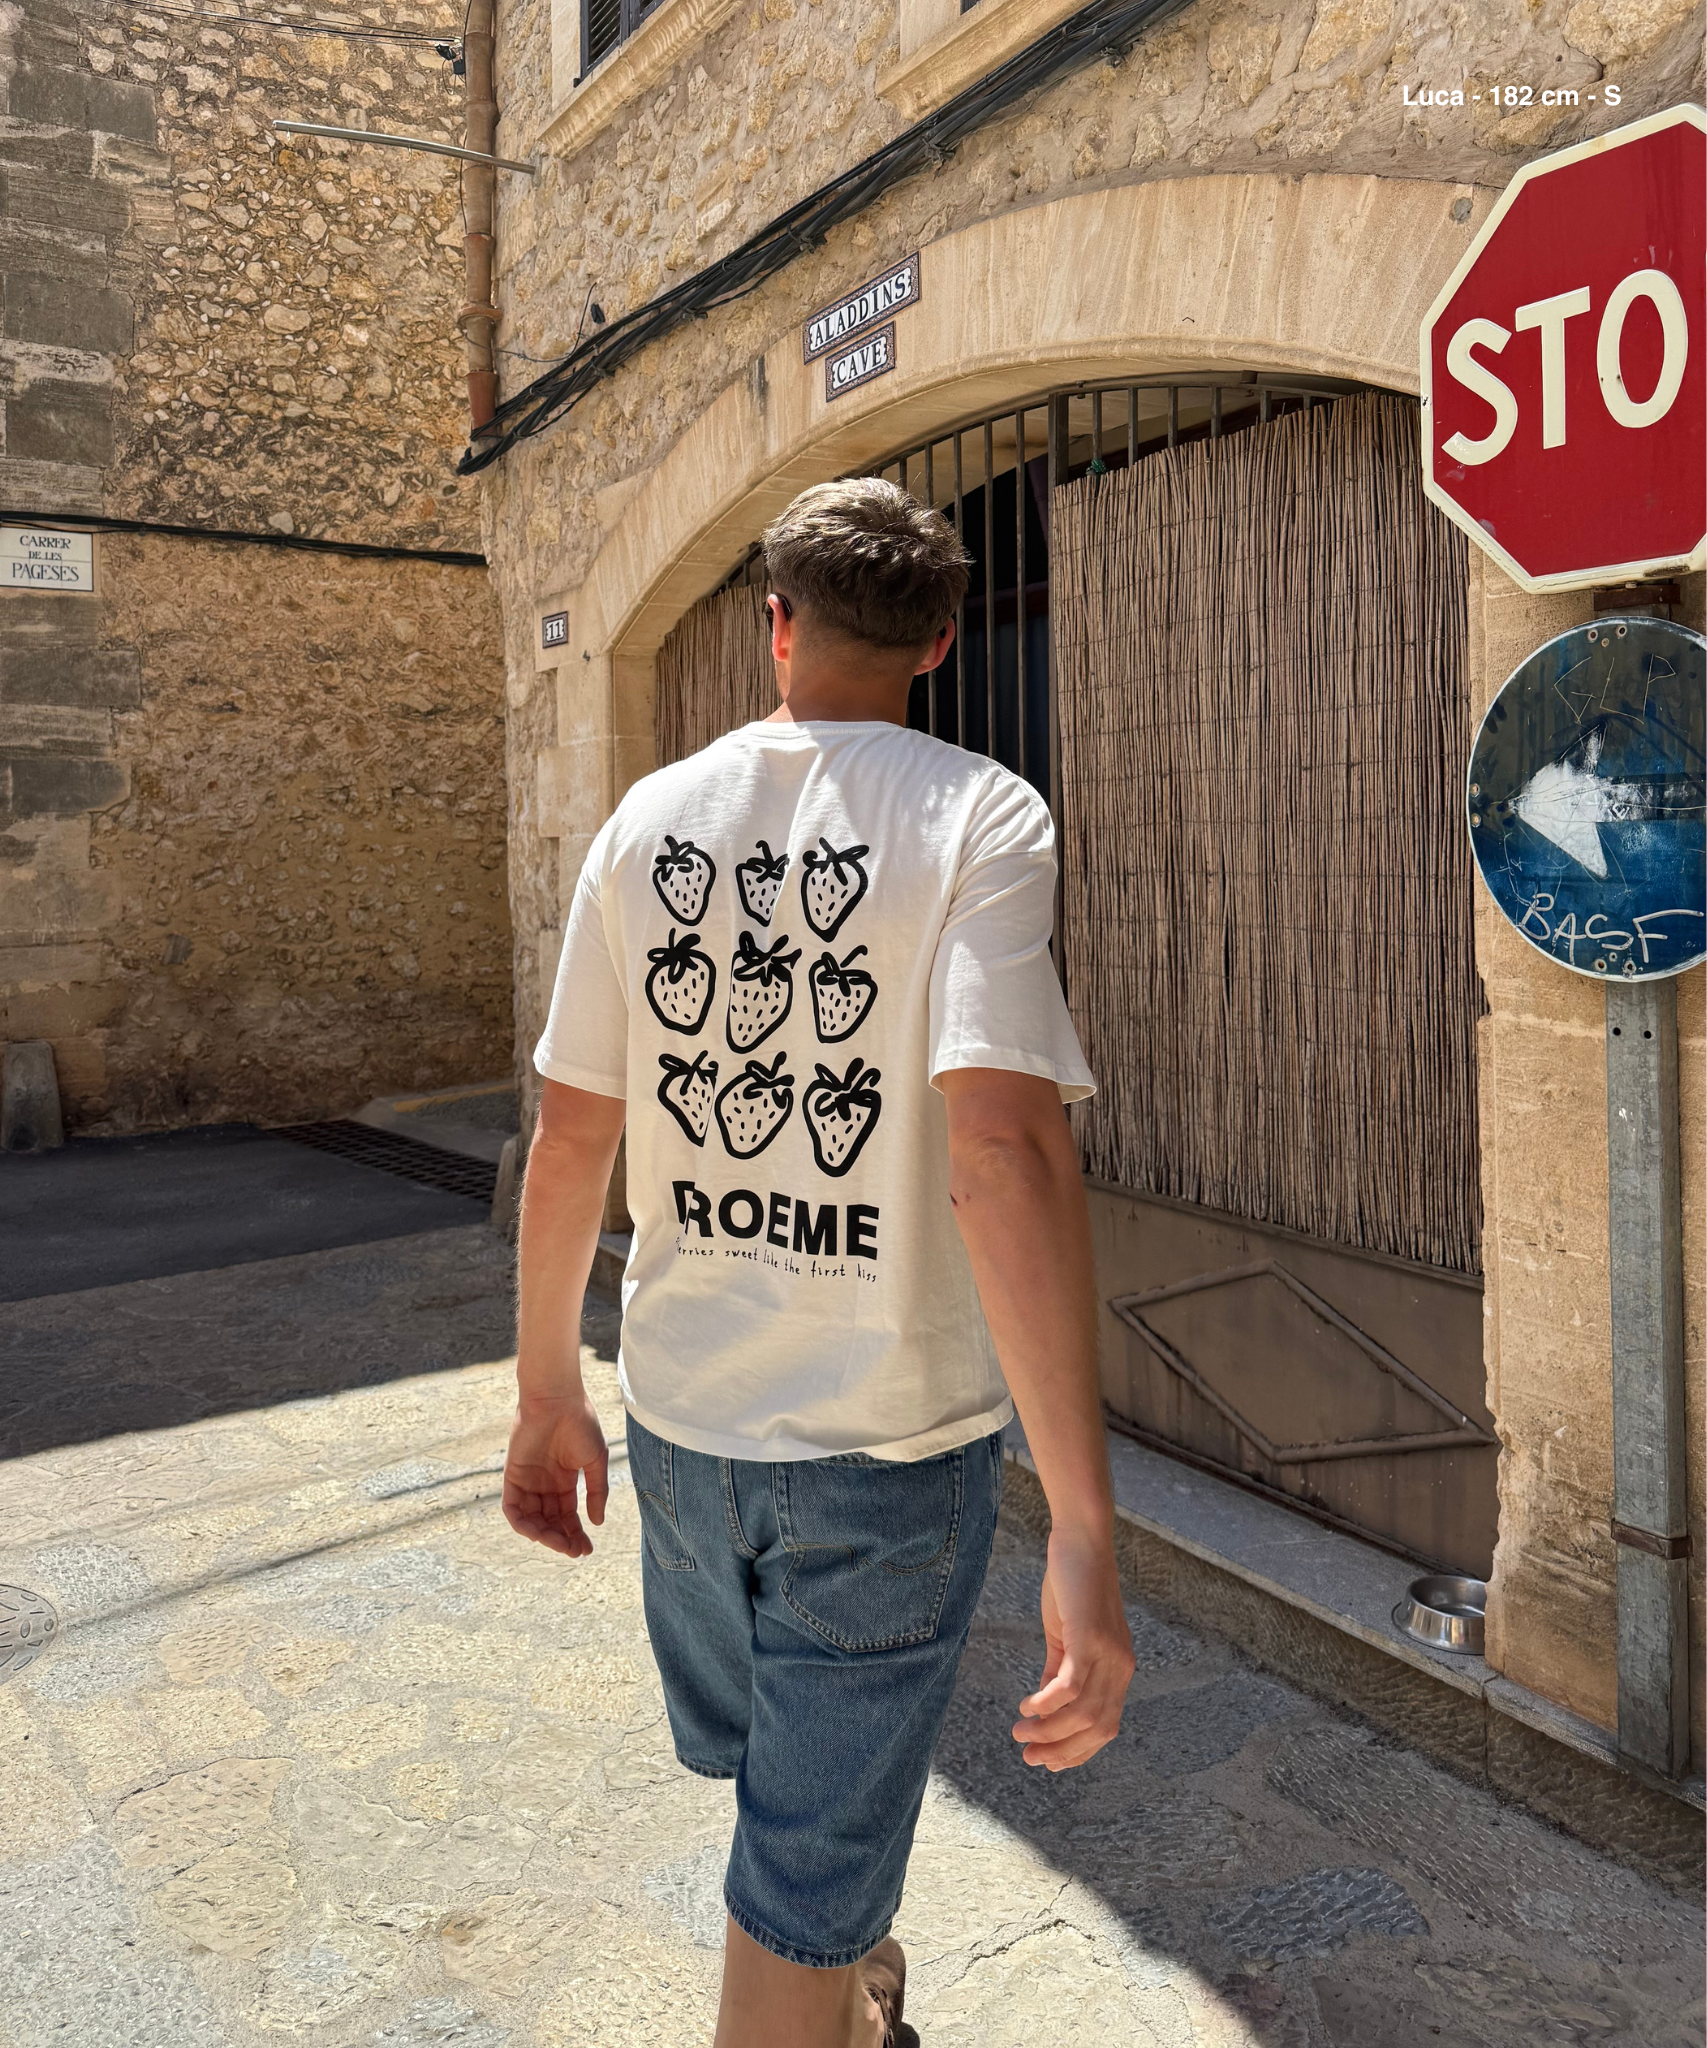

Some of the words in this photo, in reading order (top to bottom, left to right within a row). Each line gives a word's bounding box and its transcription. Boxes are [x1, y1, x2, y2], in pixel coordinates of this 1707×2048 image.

[814, 273, 906, 348] ALADDINS
[836, 340, 882, 384] CAVE
[1441, 268, 1689, 466] STO
[20, 535, 71, 549] CARRER
[29, 551, 41, 560] DE
[45, 552, 62, 561] LES
[12, 562, 79, 582] PAGESES
[549, 621, 561, 639] 11
[1517, 892, 1705, 966] BASF
[725, 1248, 758, 1261] sweet
[785, 1257, 800, 1275] the
[811, 1260, 846, 1278] first
[857, 1263, 877, 1283] kiss
